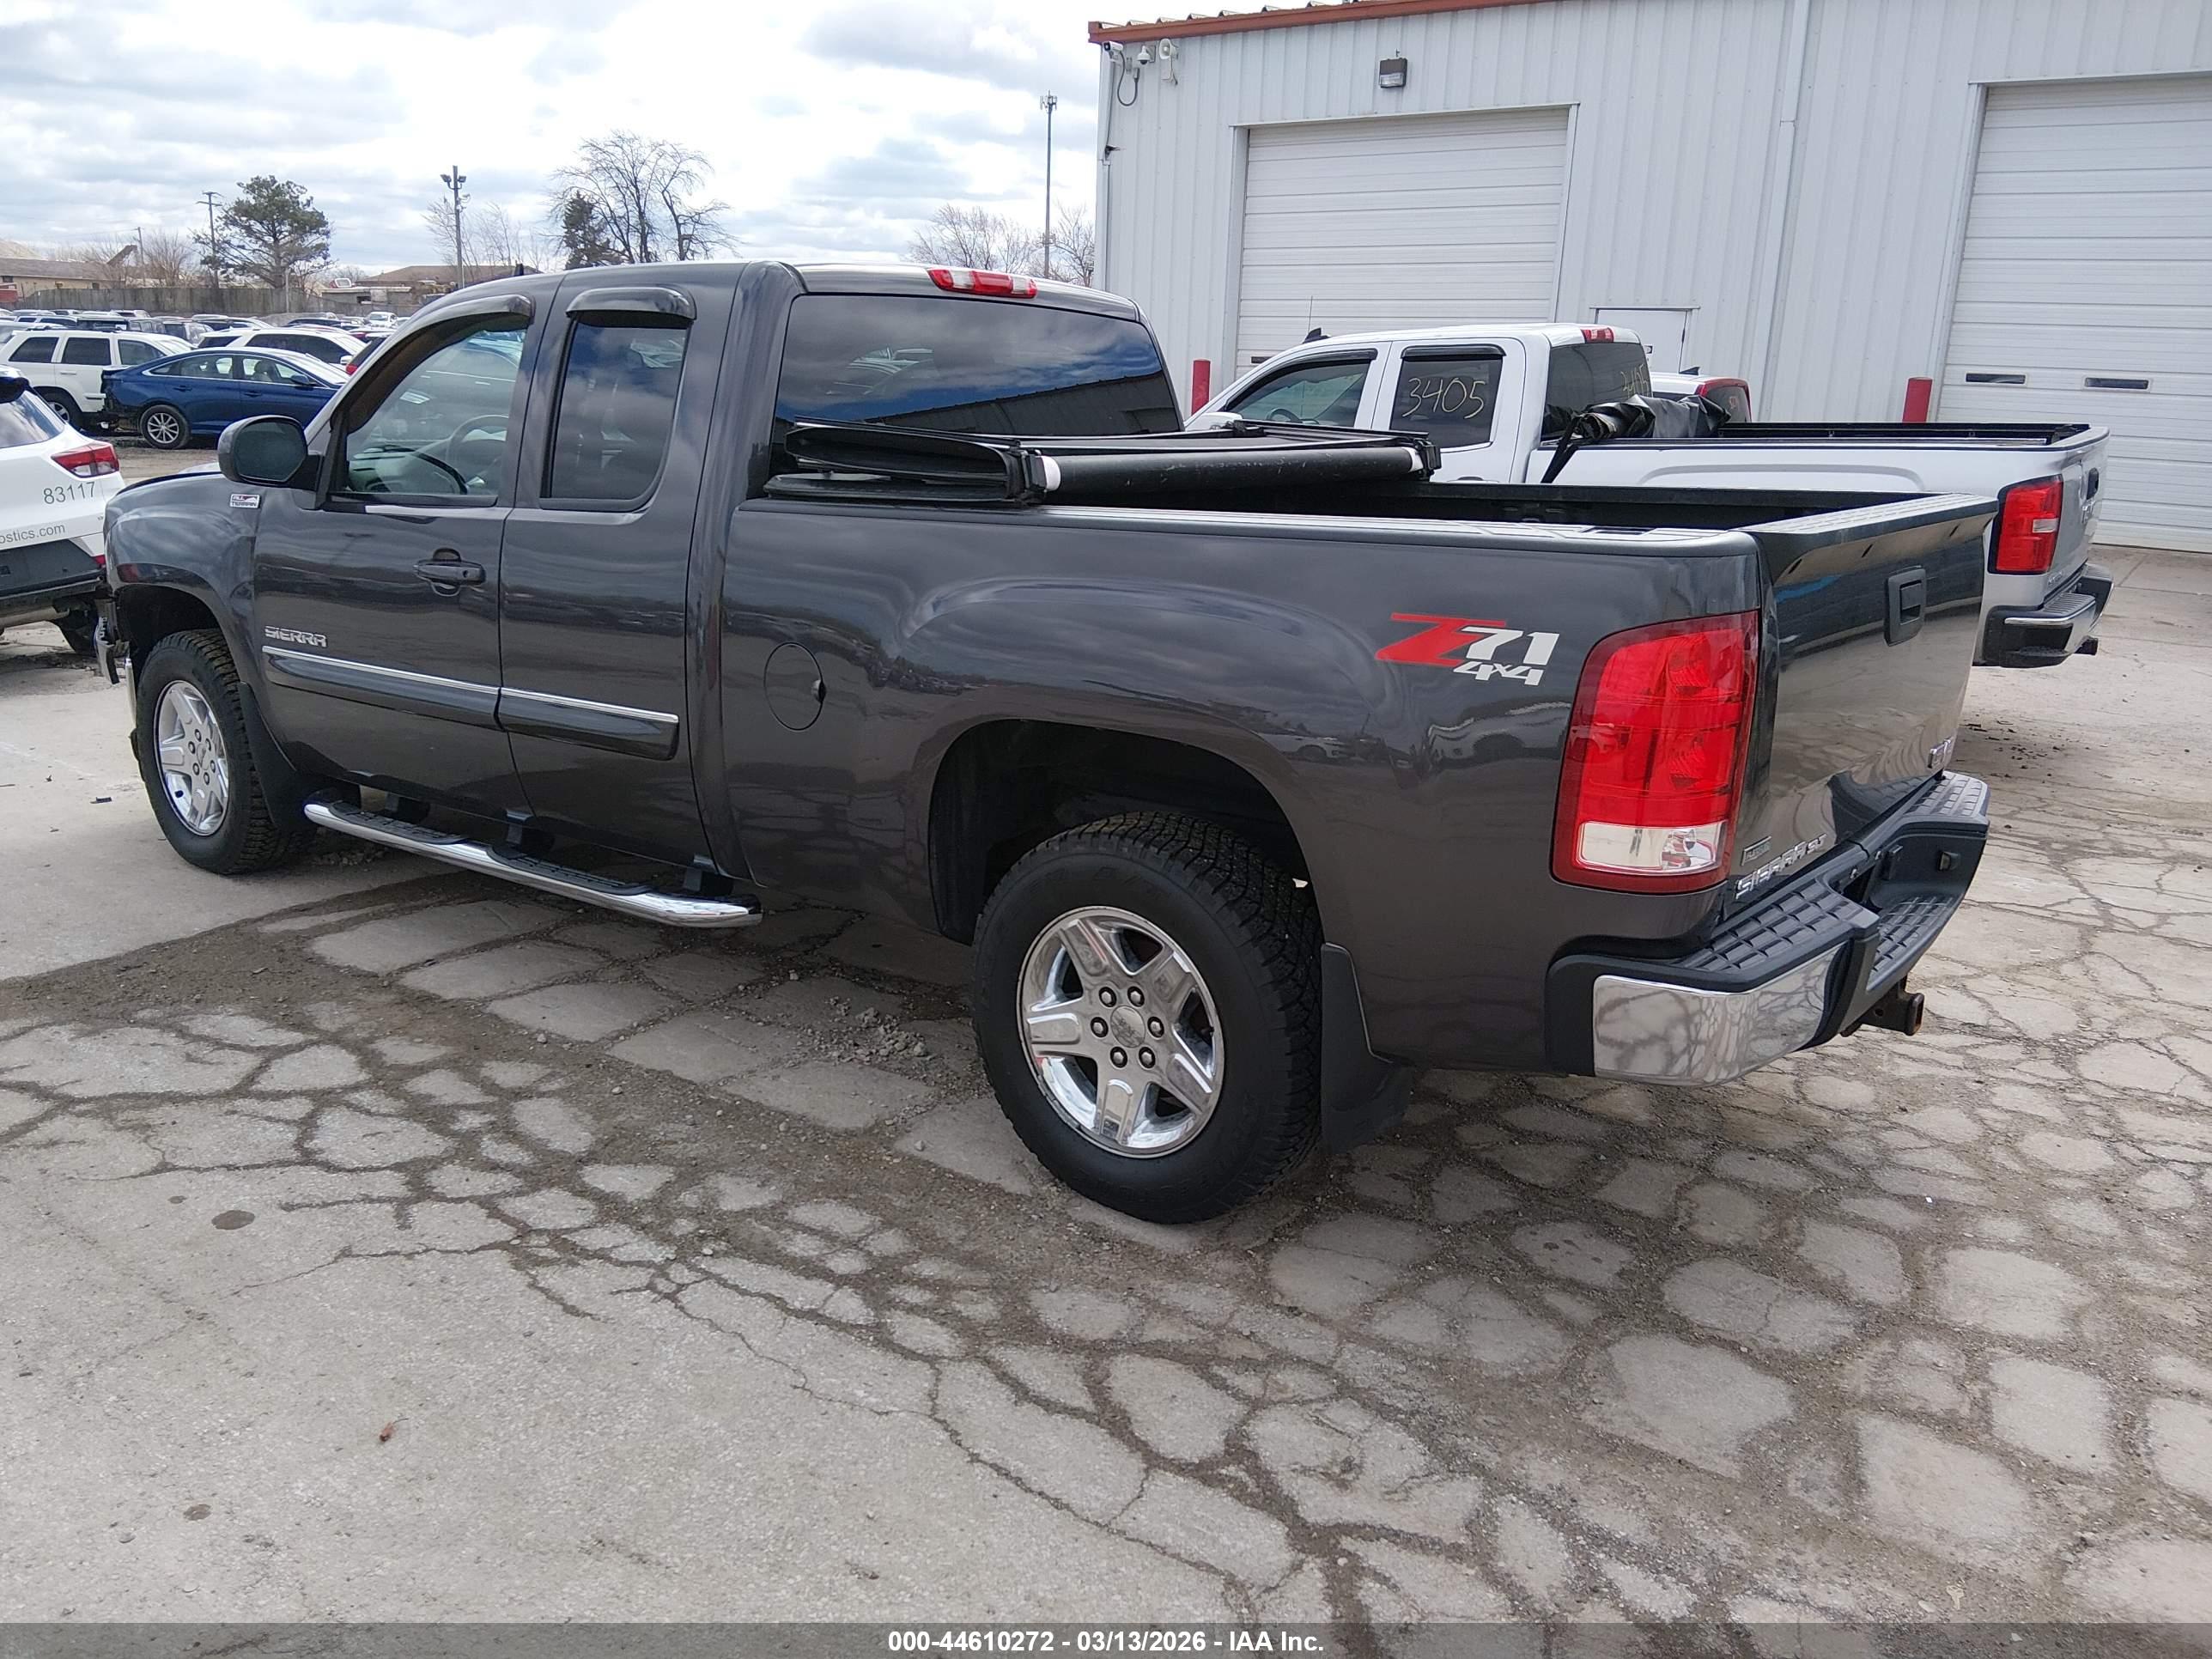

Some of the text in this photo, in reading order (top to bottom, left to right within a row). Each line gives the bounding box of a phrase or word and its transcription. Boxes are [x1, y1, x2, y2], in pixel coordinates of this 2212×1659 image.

[1401, 377, 1486, 419] 3405
[43, 481, 95, 505] 83117
[264, 625, 327, 647] SIERRA
[1375, 612, 1560, 666] Z71
[1735, 842, 1808, 900] SIERRA
